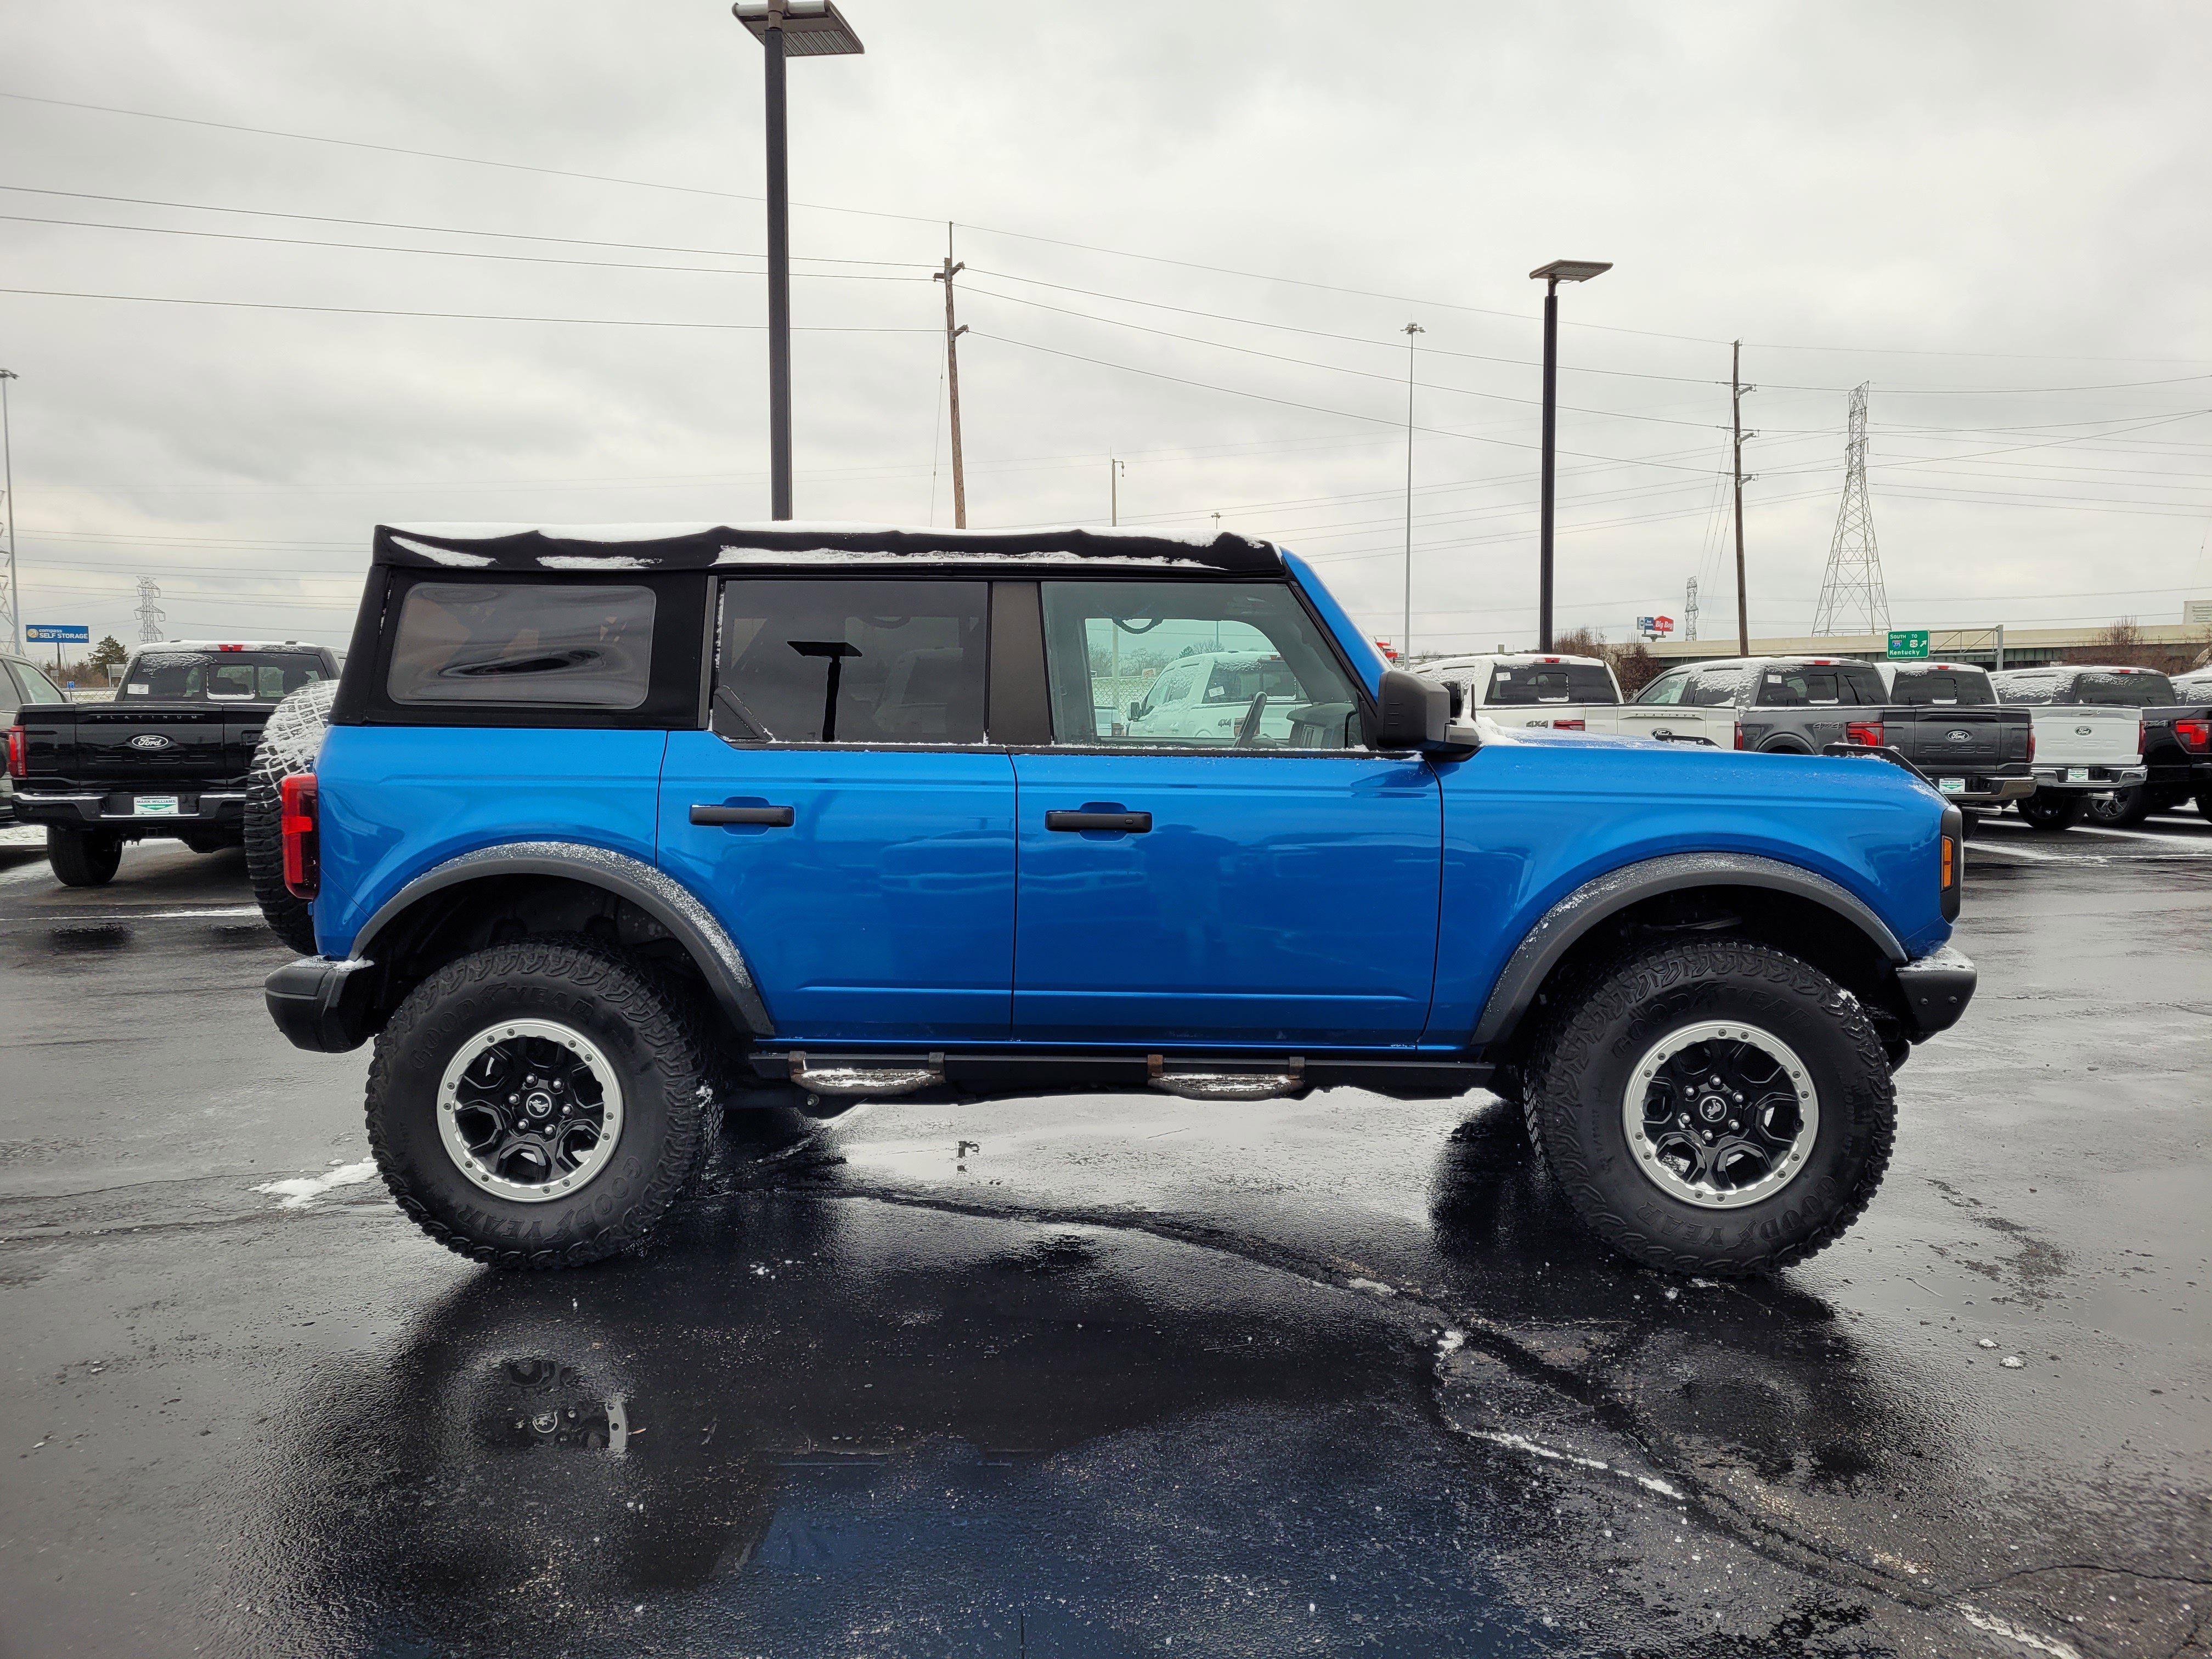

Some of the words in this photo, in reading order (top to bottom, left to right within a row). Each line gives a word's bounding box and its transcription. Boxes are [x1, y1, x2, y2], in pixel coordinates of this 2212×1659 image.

[1655, 620, 1663, 629] Big
[1664, 621, 1673, 630] Boy
[1950, 731, 1966, 740] Ford
[2078, 727, 2090, 735] Ford
[137, 736, 163, 747] Ford
